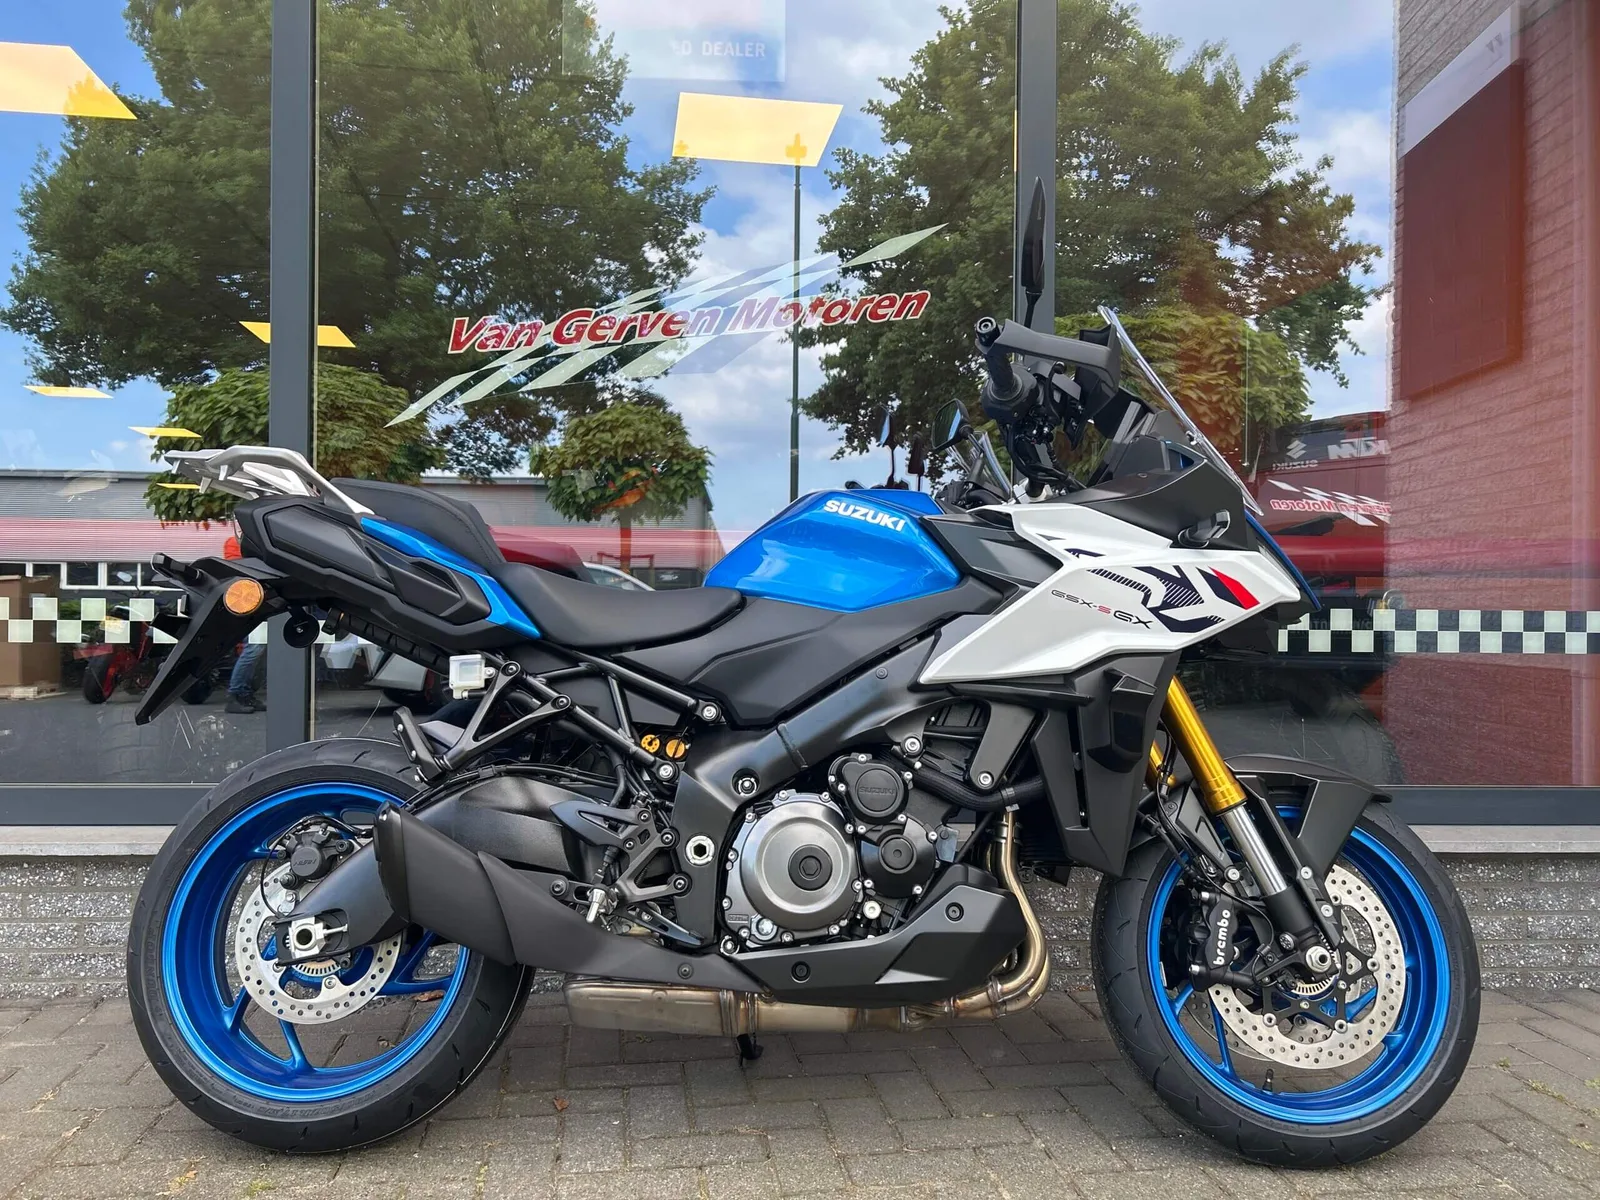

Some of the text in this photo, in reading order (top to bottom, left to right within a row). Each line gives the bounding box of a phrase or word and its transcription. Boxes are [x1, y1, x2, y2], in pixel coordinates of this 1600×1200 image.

[701, 41, 765, 57] DEALER
[448, 289, 931, 354] Van Gerven Motoren
[823, 499, 906, 532] SUZUKI
[858, 785, 897, 796] SUZUKI
[1212, 909, 1231, 966] brembo
